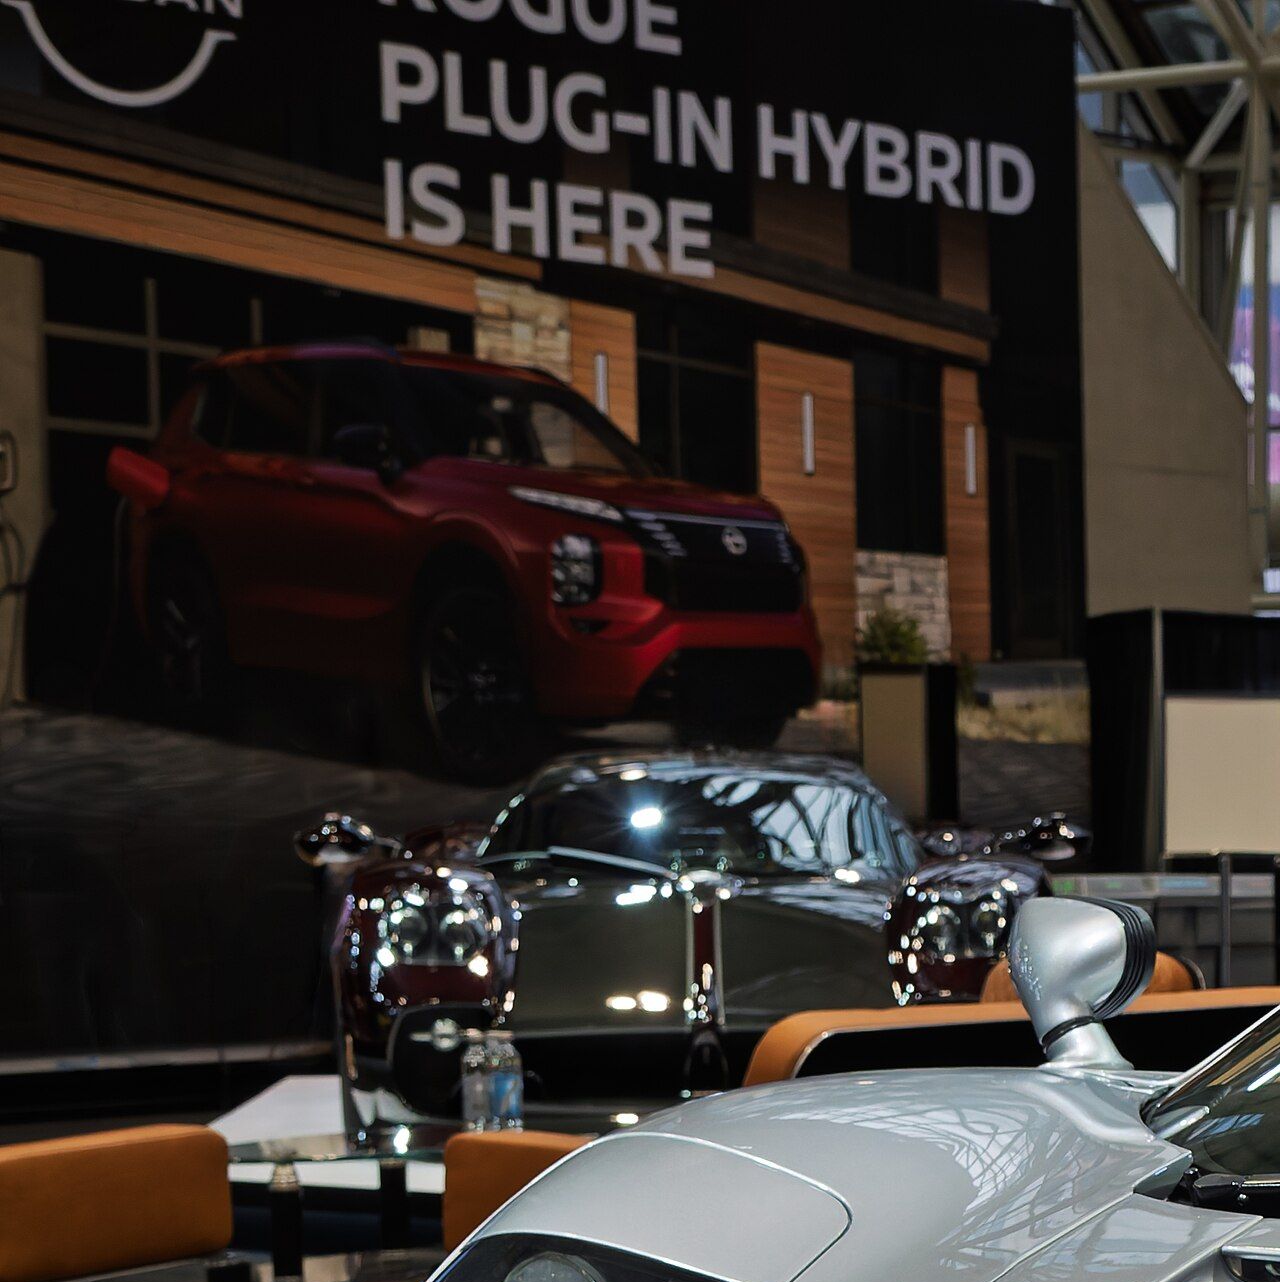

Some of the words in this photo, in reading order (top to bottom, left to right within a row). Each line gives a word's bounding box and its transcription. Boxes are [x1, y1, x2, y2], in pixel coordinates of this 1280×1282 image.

[379, 41, 734, 173] PLUG-IN
[757, 103, 1036, 216] HYBRID
[383, 158, 467, 247] IS
[491, 174, 717, 282] HERE
